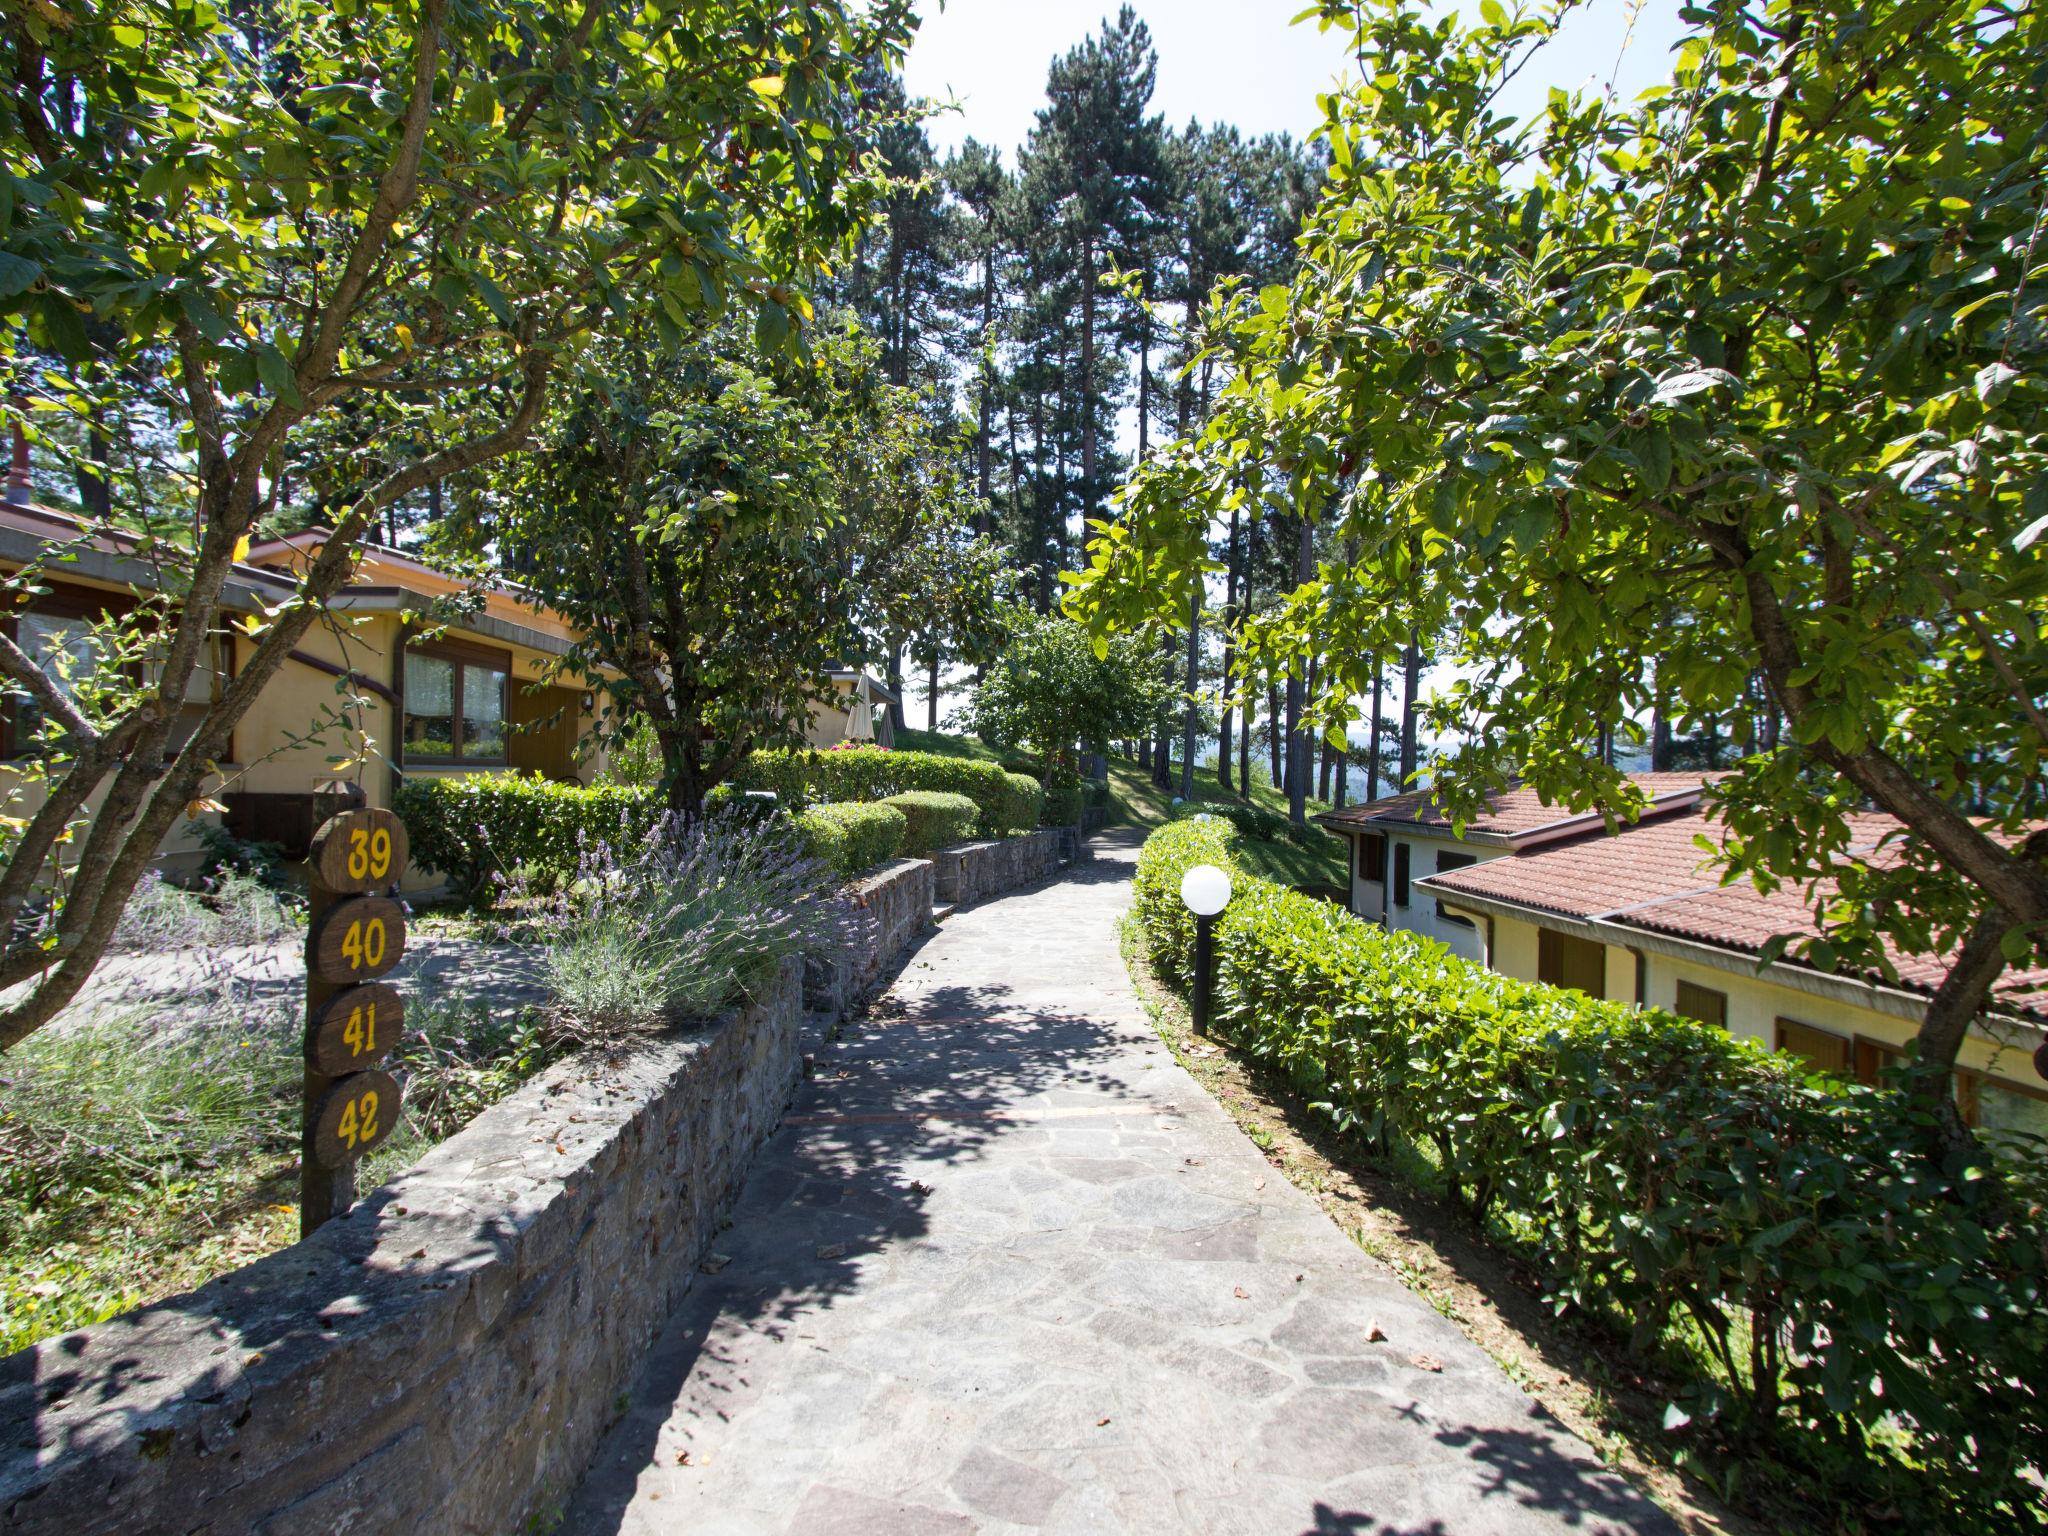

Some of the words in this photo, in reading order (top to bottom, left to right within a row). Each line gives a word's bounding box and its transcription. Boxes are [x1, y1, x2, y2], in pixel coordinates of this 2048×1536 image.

[348, 828, 391, 880] 39
[342, 918, 385, 970] 40
[343, 1002, 376, 1057] 41
[338, 1090, 379, 1149] 42
